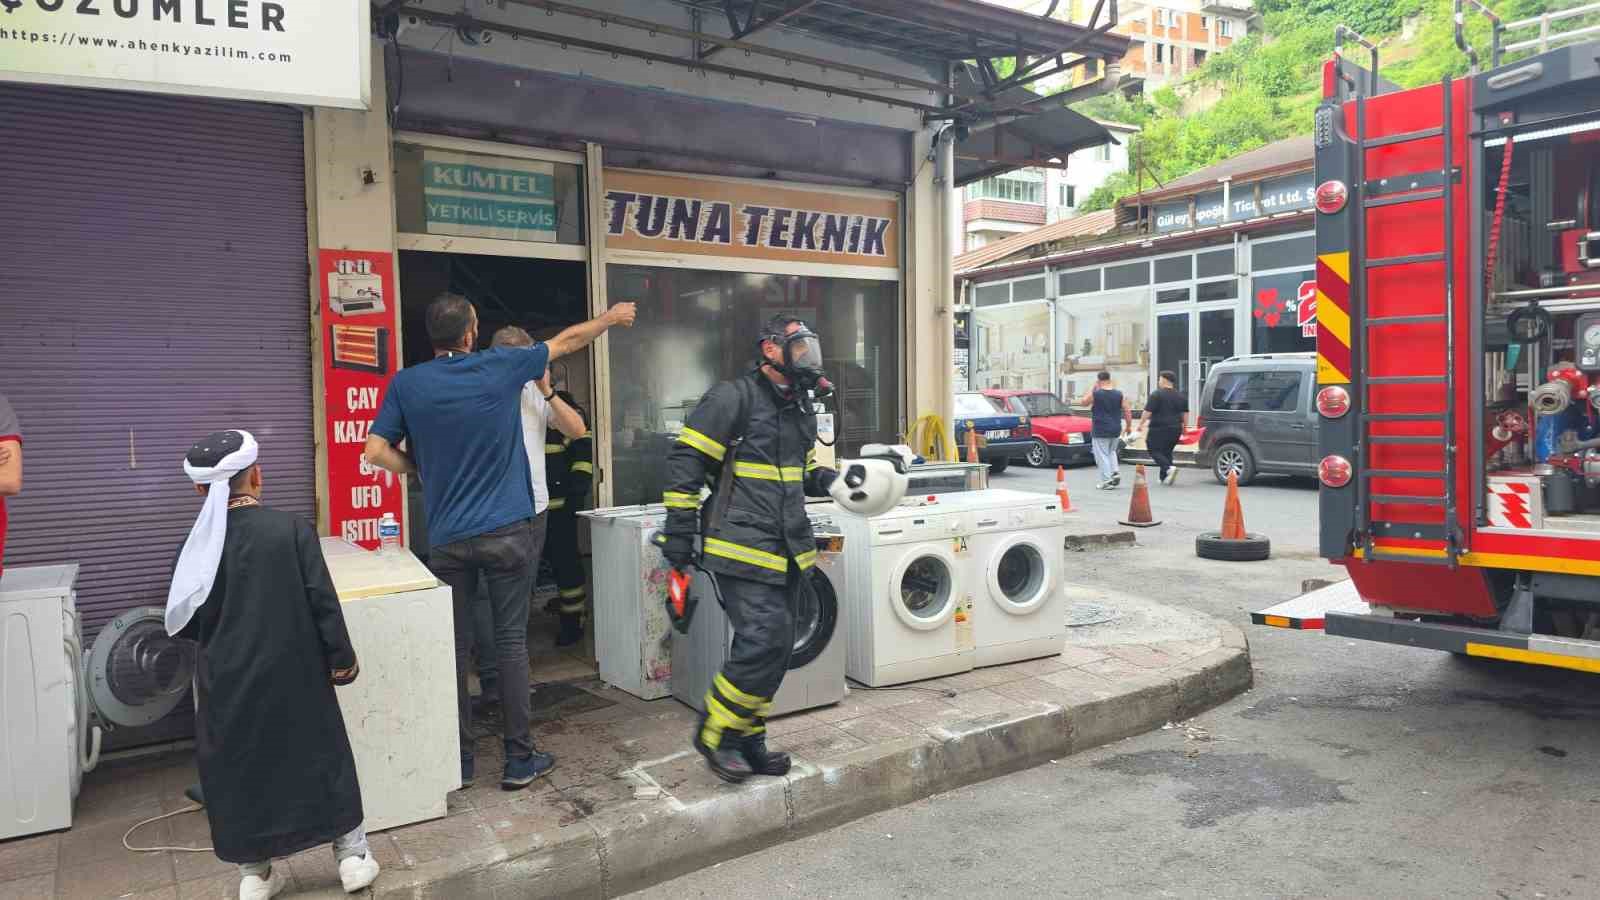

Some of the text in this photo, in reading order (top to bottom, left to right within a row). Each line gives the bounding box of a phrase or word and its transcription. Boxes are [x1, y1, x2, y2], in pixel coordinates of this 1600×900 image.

[0, 27, 292, 63] https://www.ahenkyazilim.com
[432, 166, 543, 193] KUMTEL
[496, 208, 553, 226] SERVİS
[604, 190, 732, 245] TUNA
[346, 387, 379, 412] ÇAY
[351, 485, 382, 509] UFO
